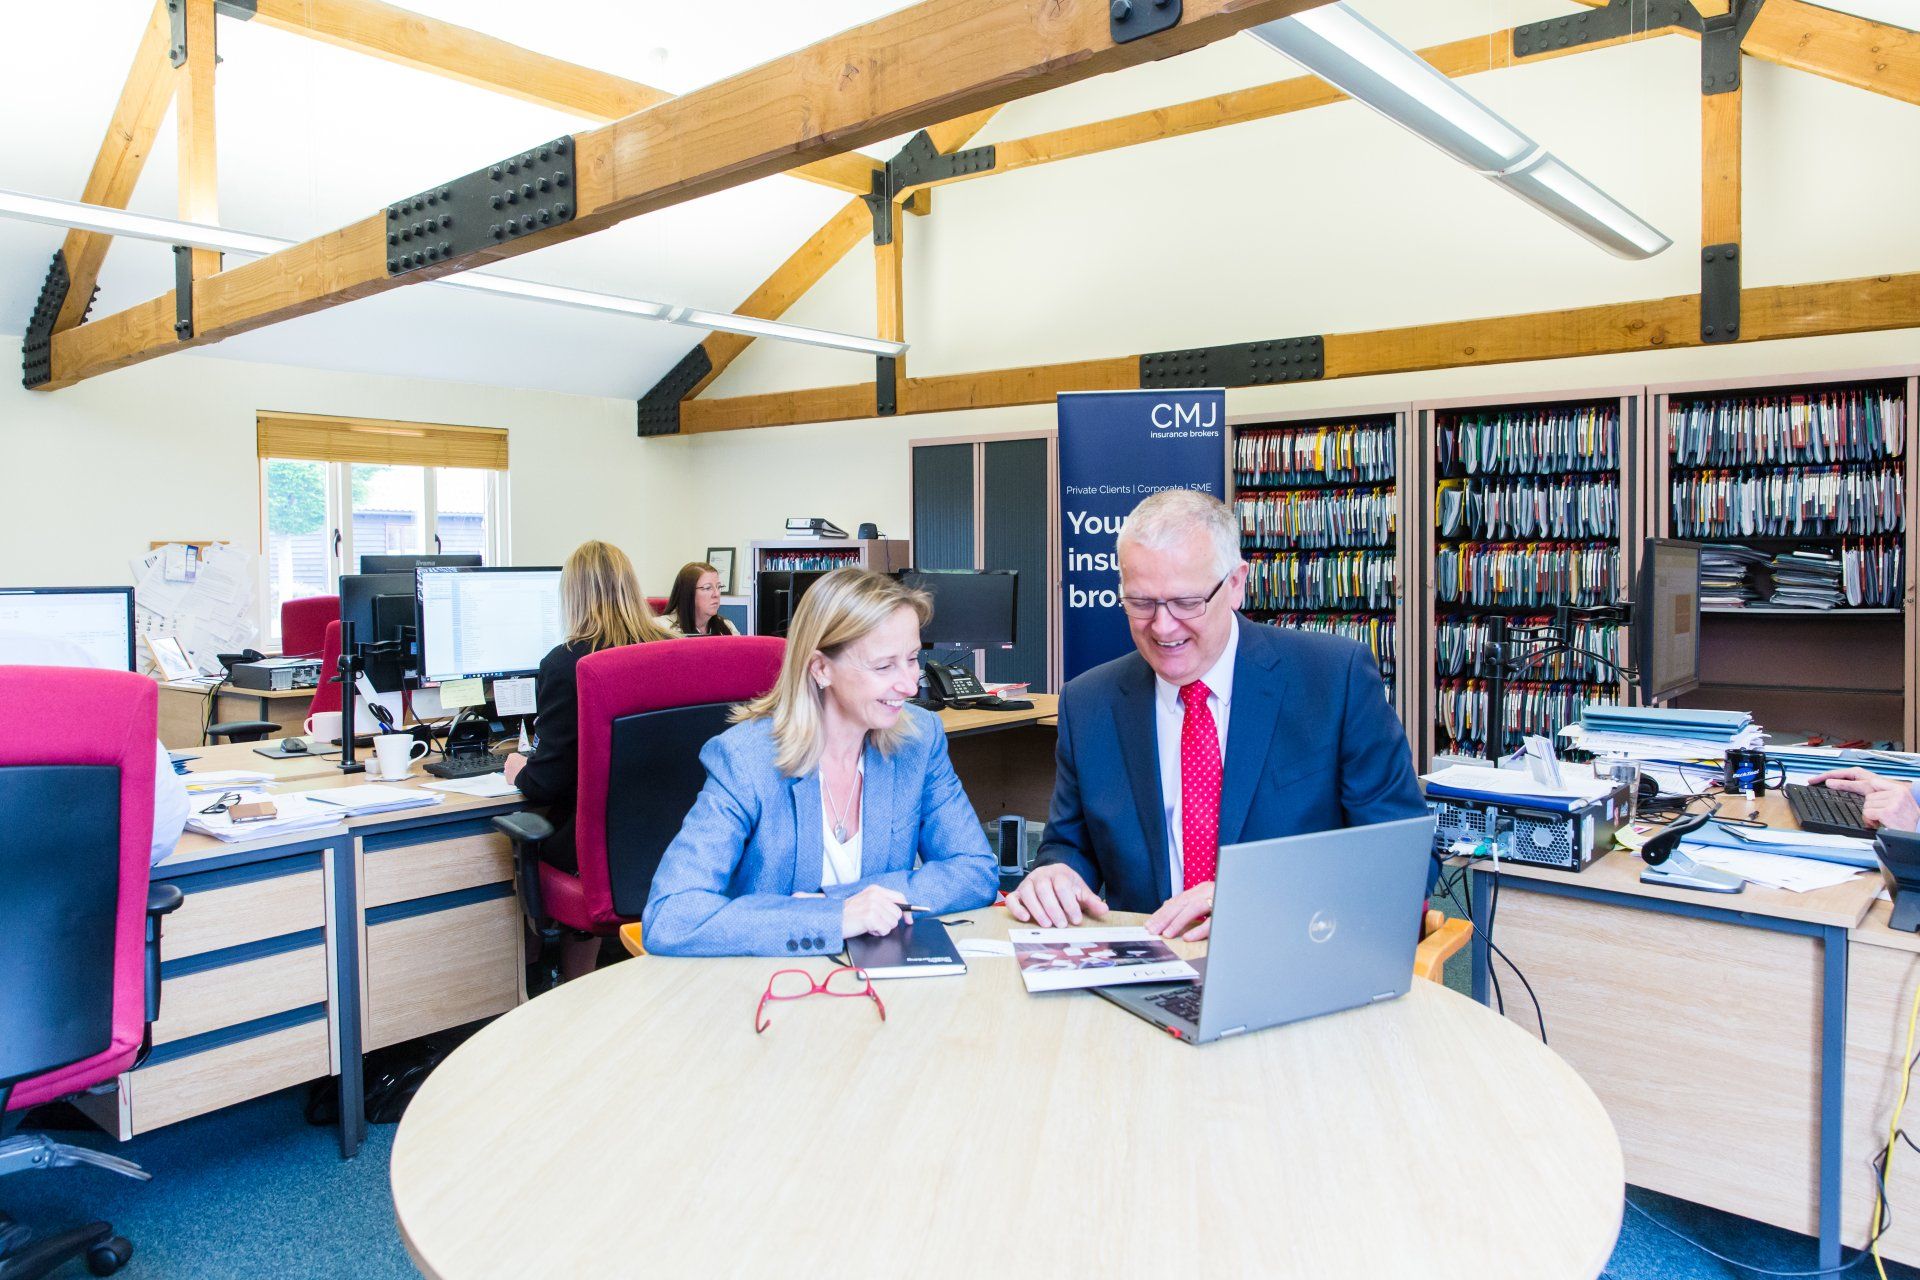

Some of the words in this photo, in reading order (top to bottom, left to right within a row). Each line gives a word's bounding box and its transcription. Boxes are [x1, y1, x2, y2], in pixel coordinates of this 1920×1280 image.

[1151, 402, 1217, 429] CMJ
[1150, 431, 1188, 439] insurance
[1190, 430, 1219, 438] brokers
[1066, 485, 1098, 495] Private
[1099, 484, 1131, 494] Clients
[1190, 482, 1212, 492] SME
